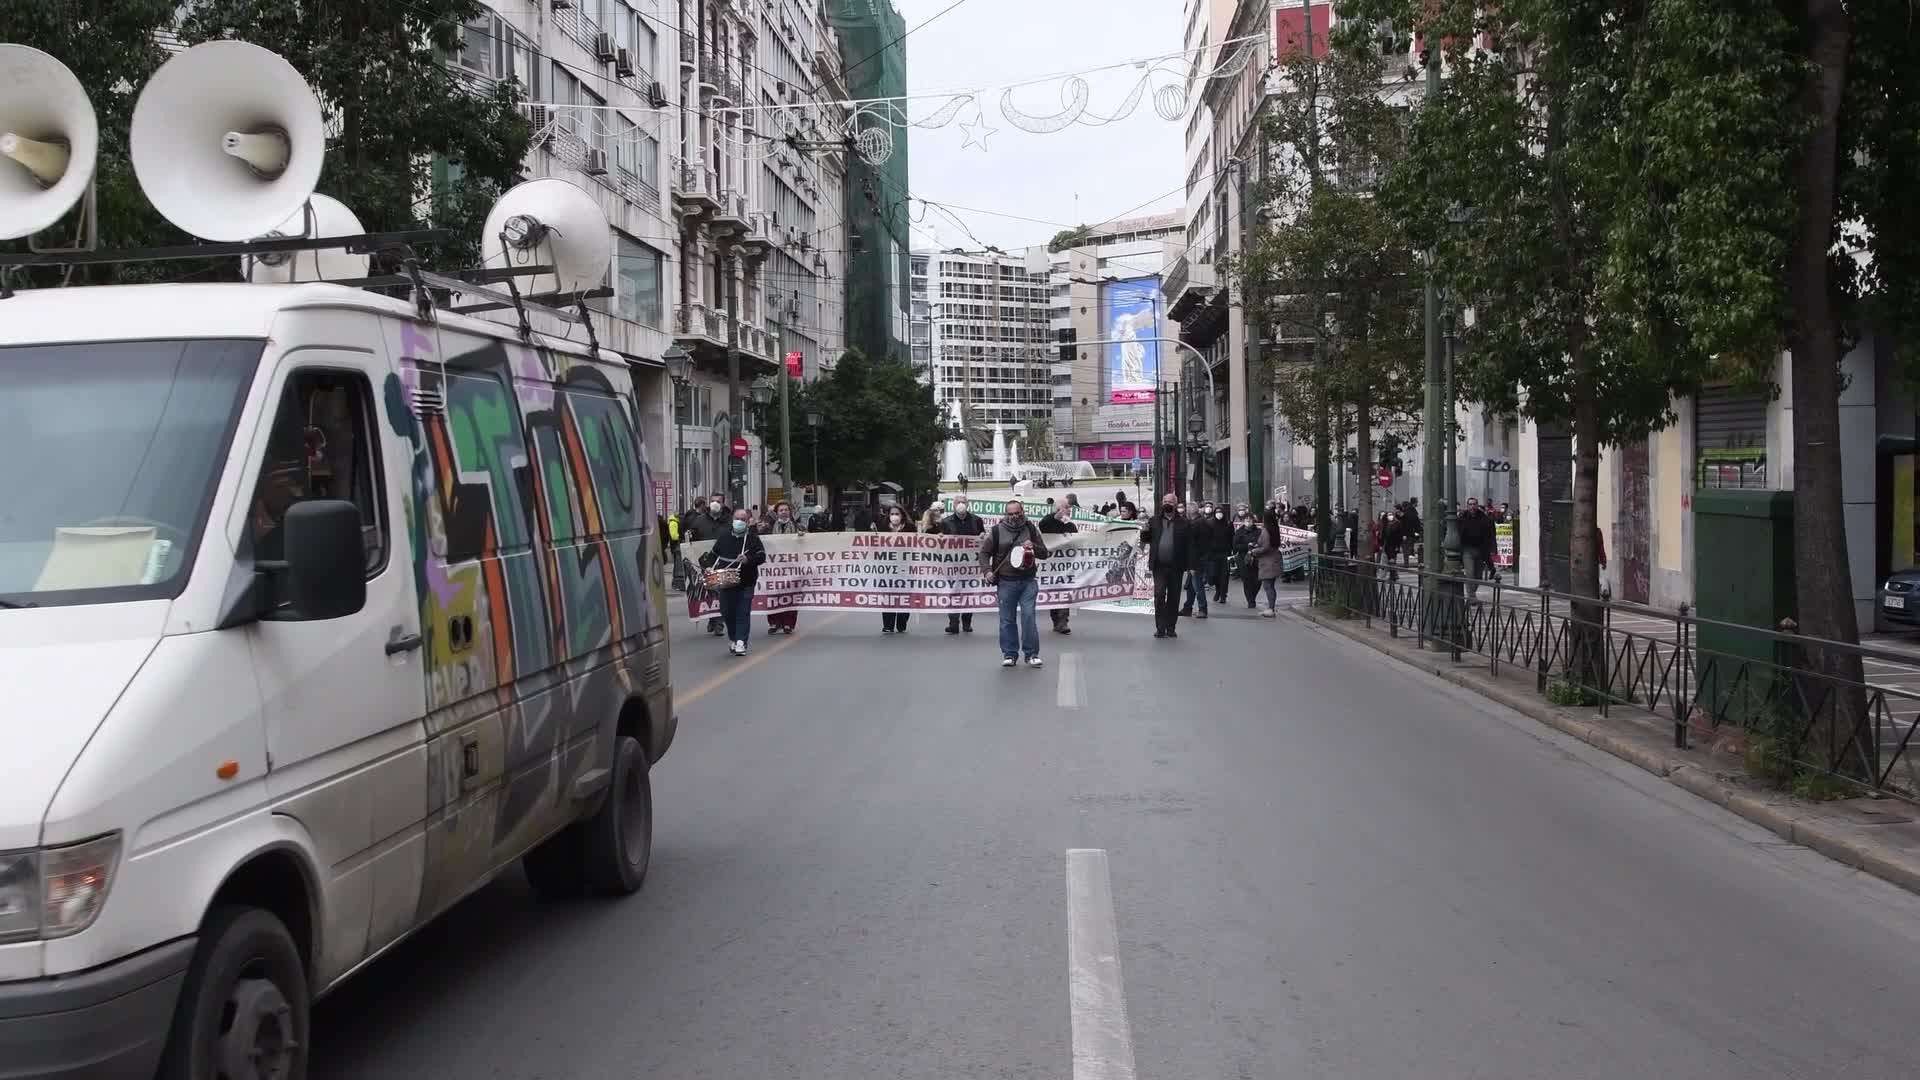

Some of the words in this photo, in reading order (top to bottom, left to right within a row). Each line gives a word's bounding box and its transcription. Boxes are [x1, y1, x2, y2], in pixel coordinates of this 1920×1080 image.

[1023, 505, 1051, 517] ΕΚΡΟΙ
[852, 534, 980, 549] ΔΙΕΚΔΙΚΟΥΜΕ:
[766, 553, 798, 563] ΥΣΗ
[803, 551, 836, 561] ΤΟΥ
[841, 550, 869, 560] ΕΣΥ
[873, 551, 897, 561] ΜΕ
[902, 551, 970, 563] ΓΕΝΝΑΙΑ
[760, 565, 813, 577] ΓΝΩΣΤΙΚΑ
[817, 564, 842, 574] ΤΕΣΤ
[845, 564, 861, 574] ΓΙΑ
[863, 564, 898, 575] ΟΛΟΥΣ
[908, 565, 945, 576] ΜΕΤΡΑ
[1050, 562, 1093, 572] ΧΩΡΟΥΣ
[765, 577, 833, 591] ΕΠΙΤΑΞΗ
[838, 577, 871, 587] ΤΟΥ
[873, 578, 956, 589] ΙΔΙΩΤΙΚΟΥ
[766, 593, 841, 608] ΠΟΕΔΗΝ
[854, 594, 911, 607] ΟΕΝΓΕ
